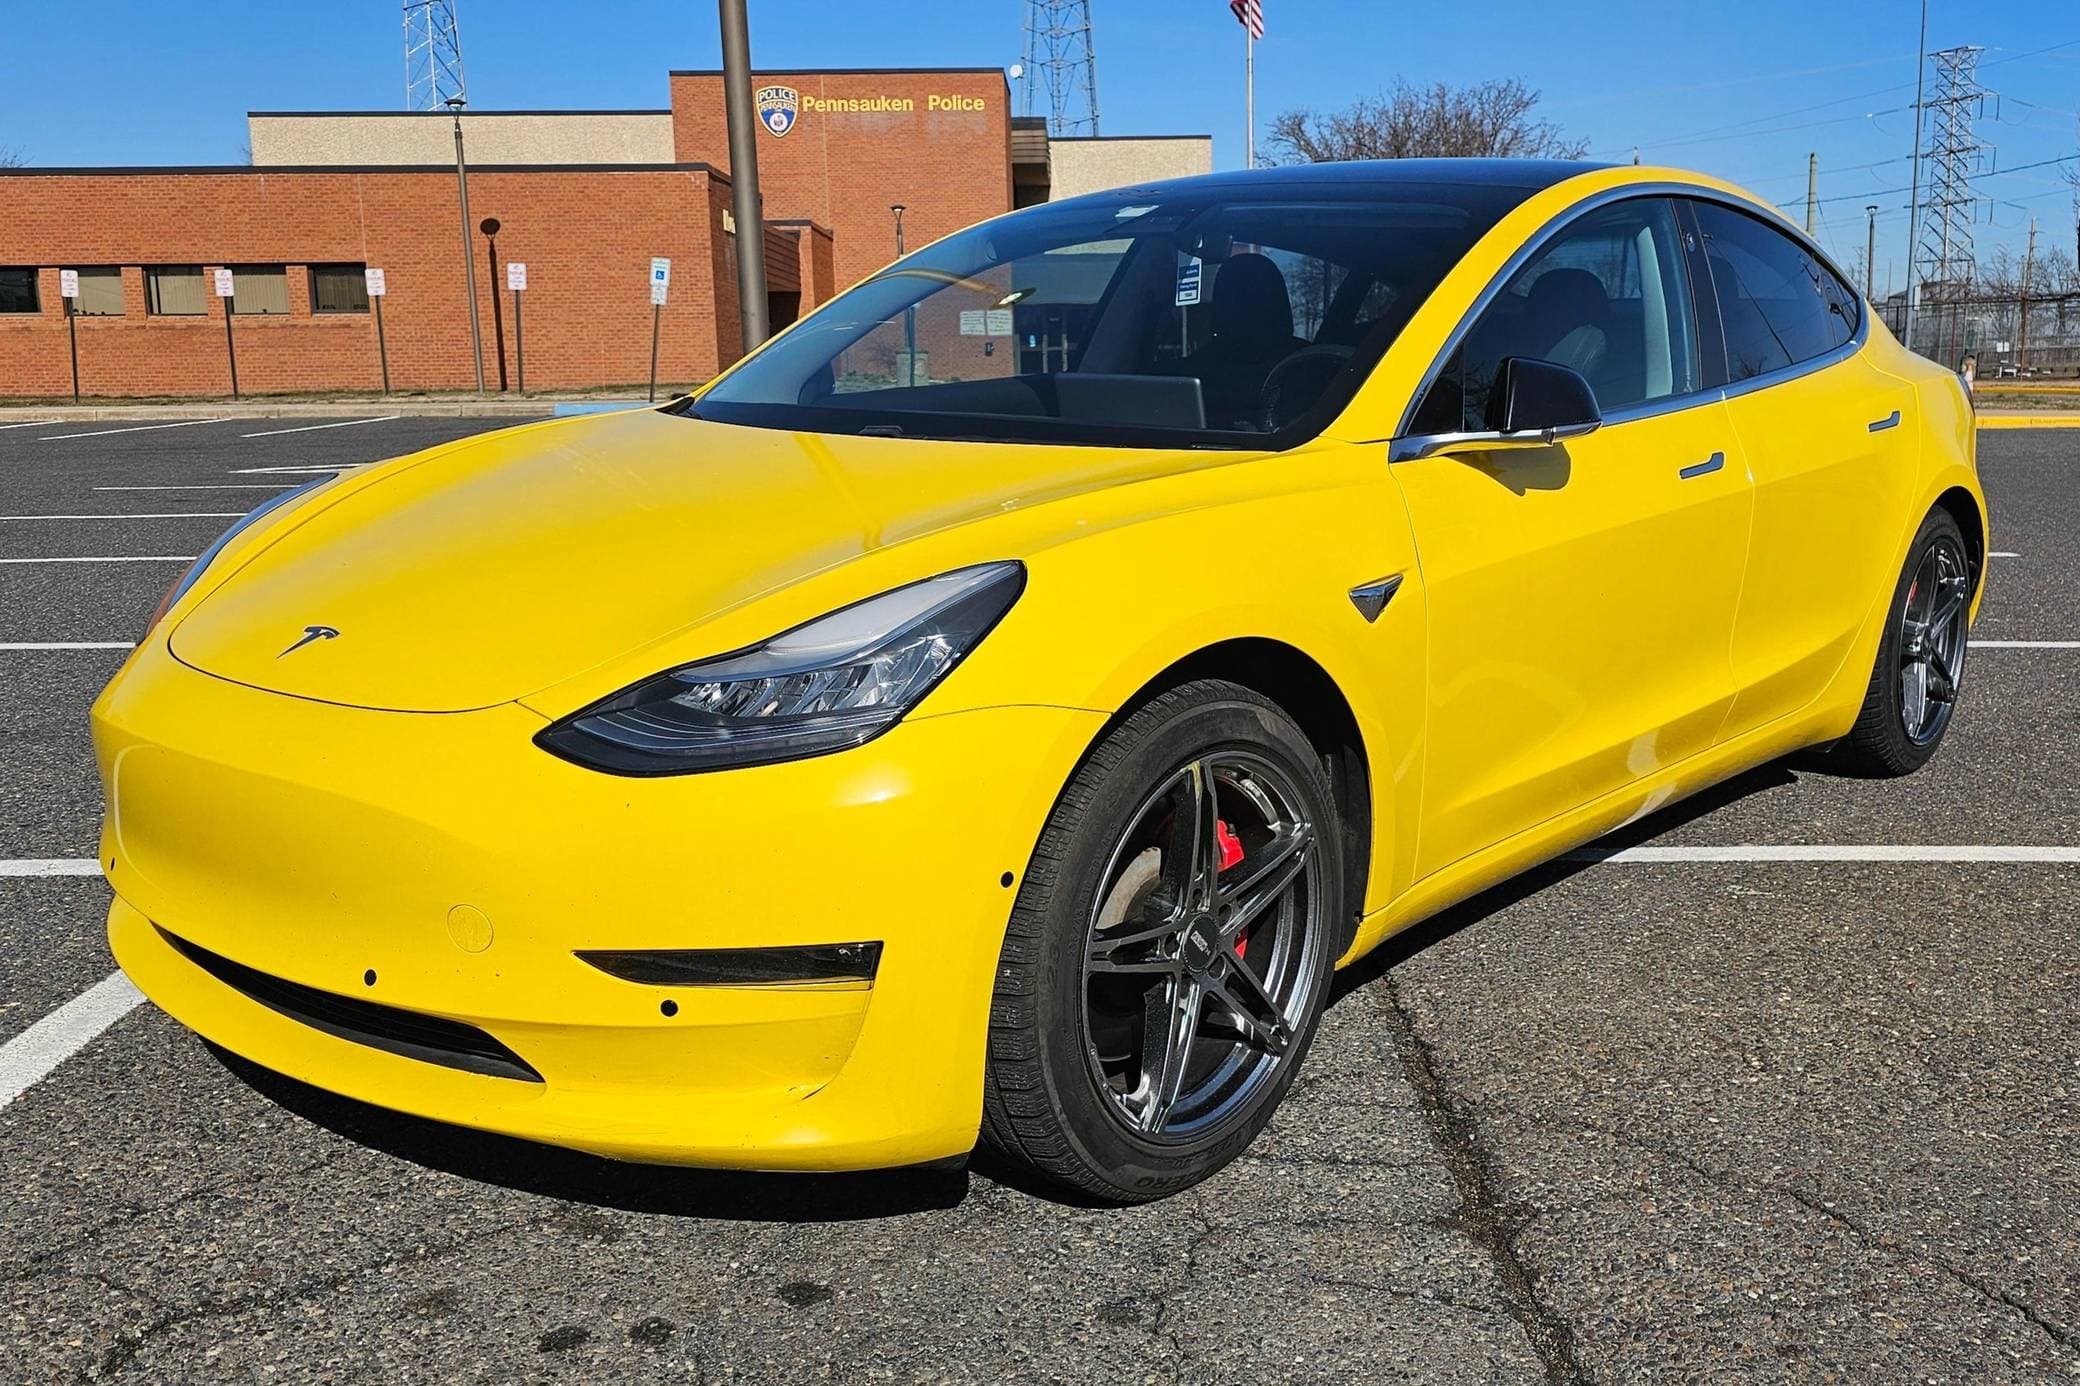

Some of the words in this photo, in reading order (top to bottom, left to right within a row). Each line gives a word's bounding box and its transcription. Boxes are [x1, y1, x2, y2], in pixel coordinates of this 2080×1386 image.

[759, 89, 795, 102] POLICE
[803, 96, 914, 112] Pennsauken
[929, 95, 985, 111] Police
